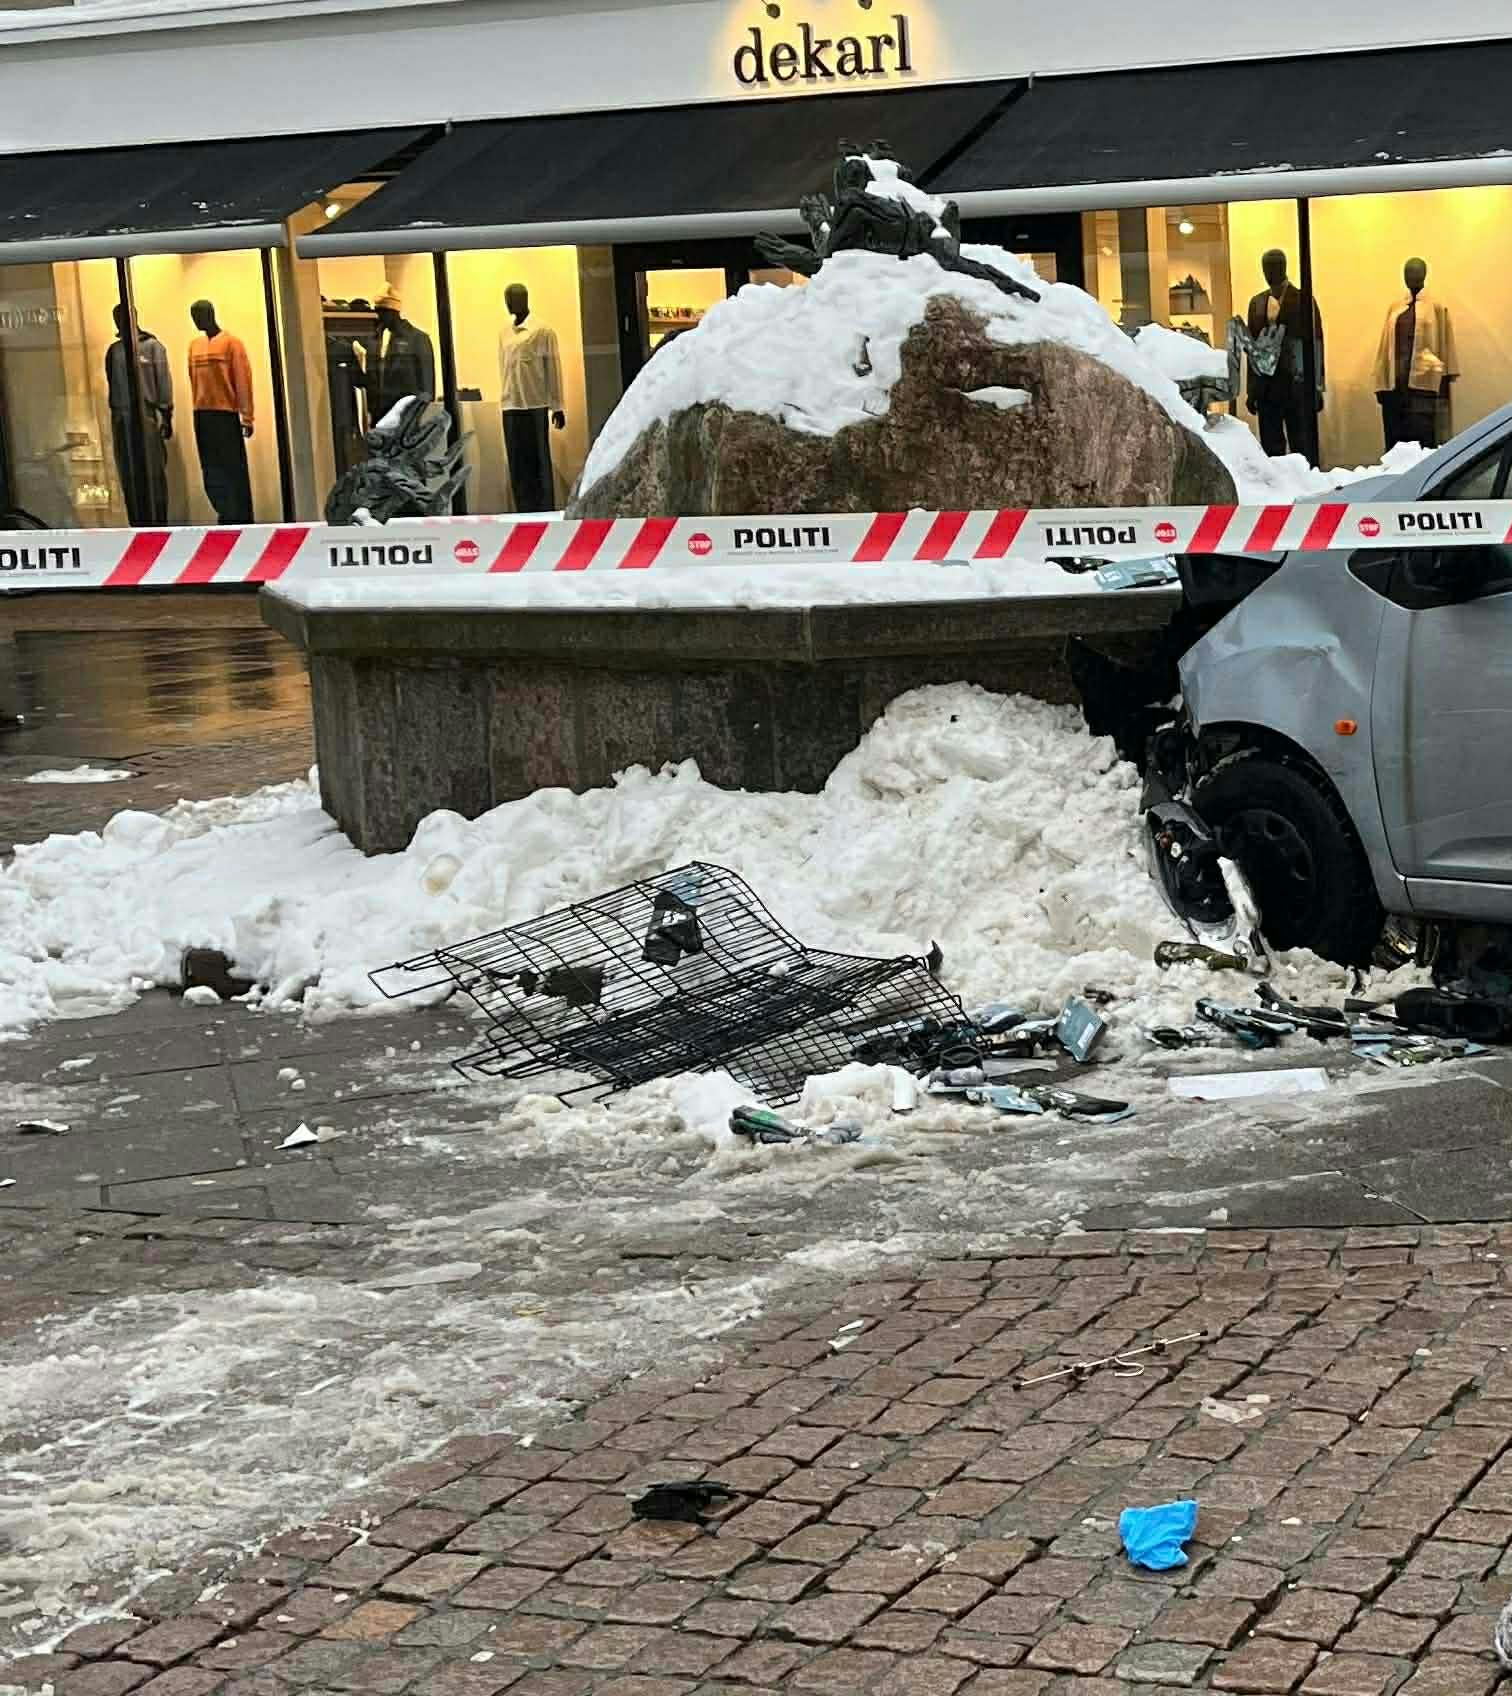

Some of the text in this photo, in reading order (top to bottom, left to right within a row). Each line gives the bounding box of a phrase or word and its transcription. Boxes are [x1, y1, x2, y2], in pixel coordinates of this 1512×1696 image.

[734, 14, 911, 84] dekarl
[1359, 512, 1482, 533] STOP POLITI
[688, 527, 831, 550] STOP POLITI
[1046, 526, 1137, 546] POLITI
[0, 547, 80, 570] OLITI
[330, 544, 433, 567] POLITI
